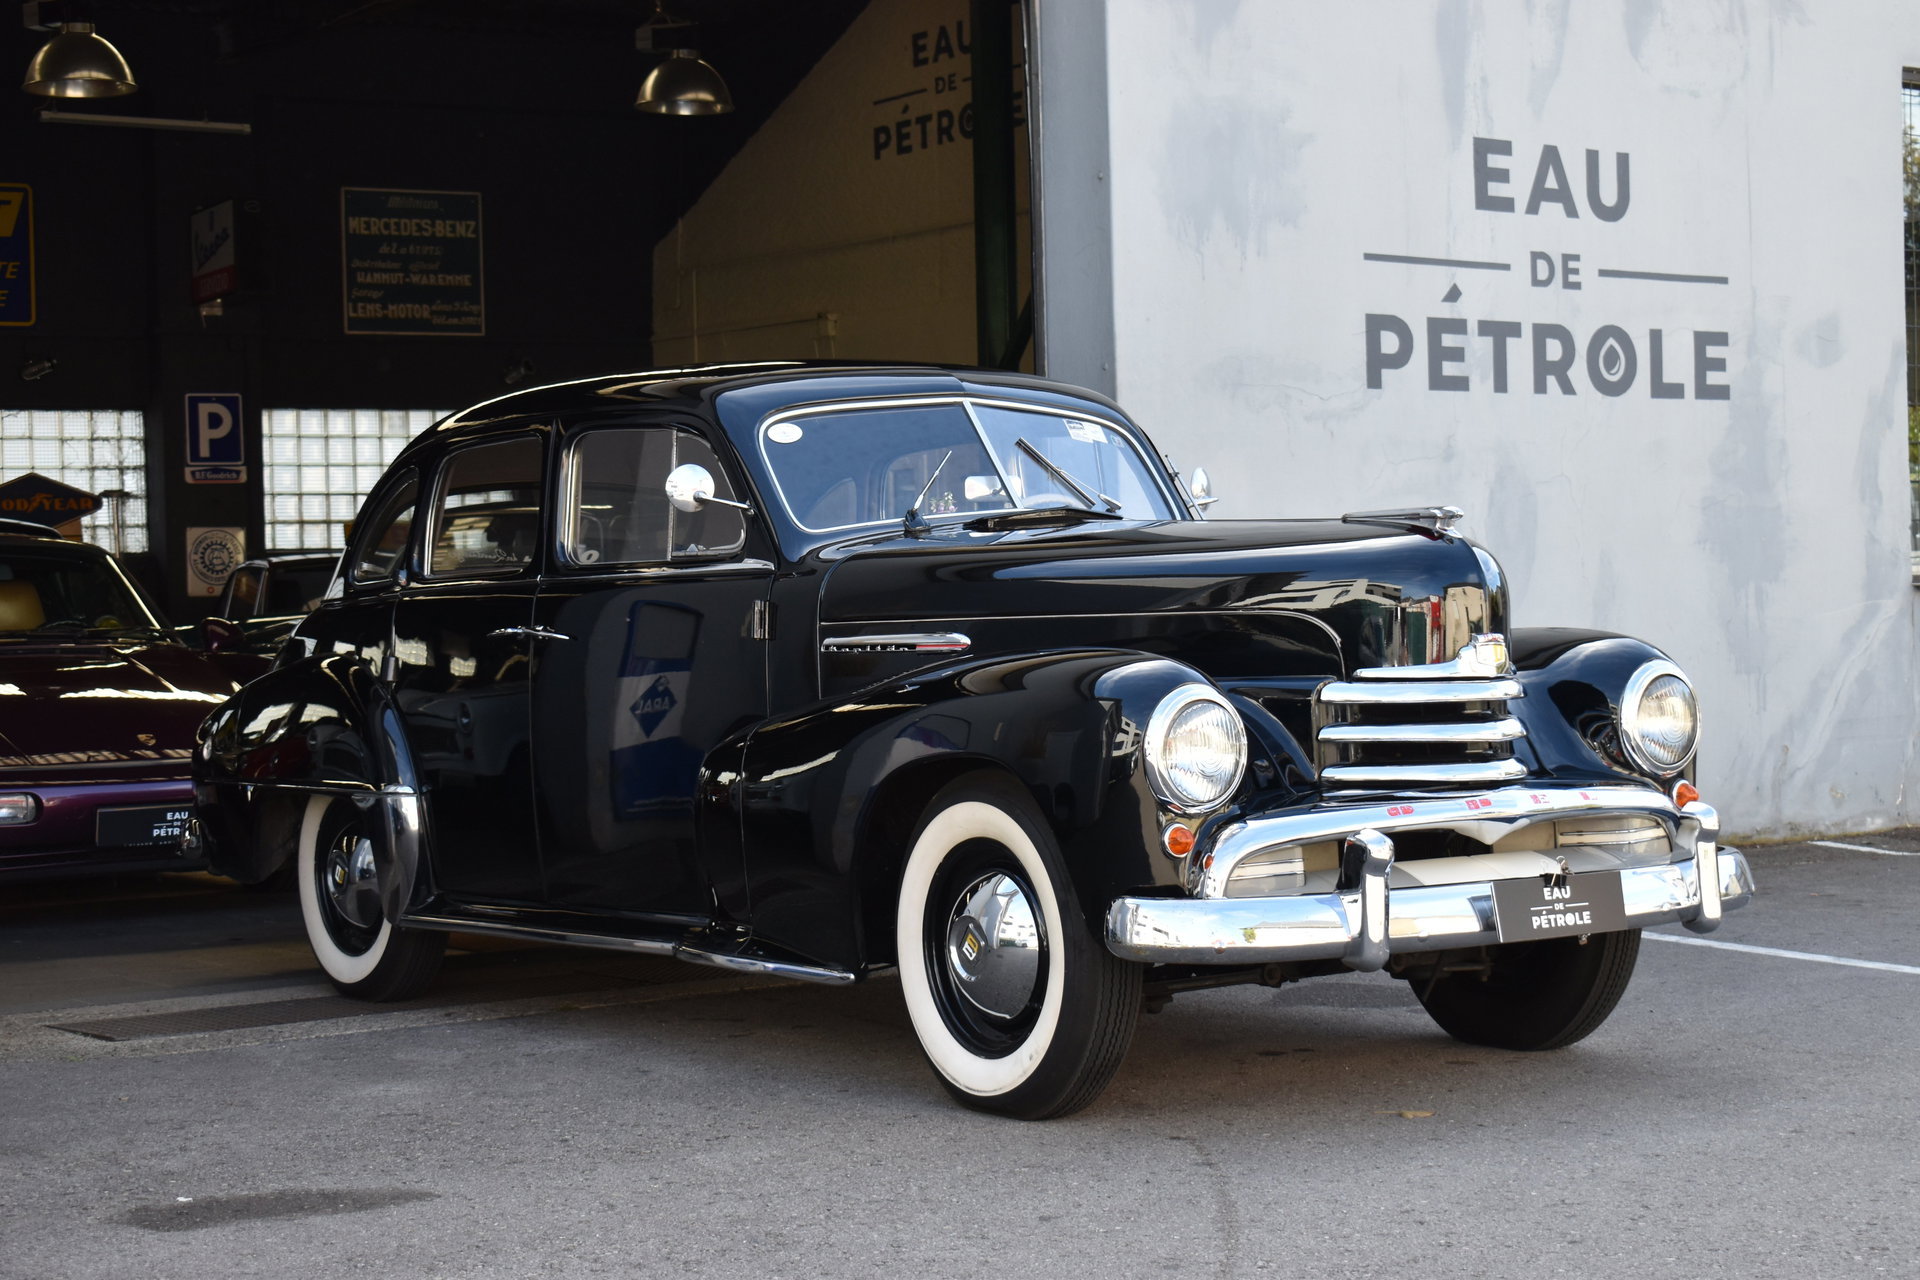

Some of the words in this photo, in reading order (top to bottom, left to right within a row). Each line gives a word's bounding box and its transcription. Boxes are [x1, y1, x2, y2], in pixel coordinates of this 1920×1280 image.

[911, 20, 973, 67] EAU
[934, 73, 957, 94] DE
[1473, 137, 1630, 222] EAU
[348, 216, 477, 238] MERCEDES-BENZ
[1530, 251, 1582, 290] DE
[1364, 282, 1731, 400] PÉTROLE
[198, 402, 233, 458] P
[166, 811, 189, 821] EAU
[153, 826, 182, 837] PÉTR
[1543, 886, 1571, 901] EAU
[1553, 902, 1565, 911] DE
[1531, 910, 1592, 930] PÉTROLE
